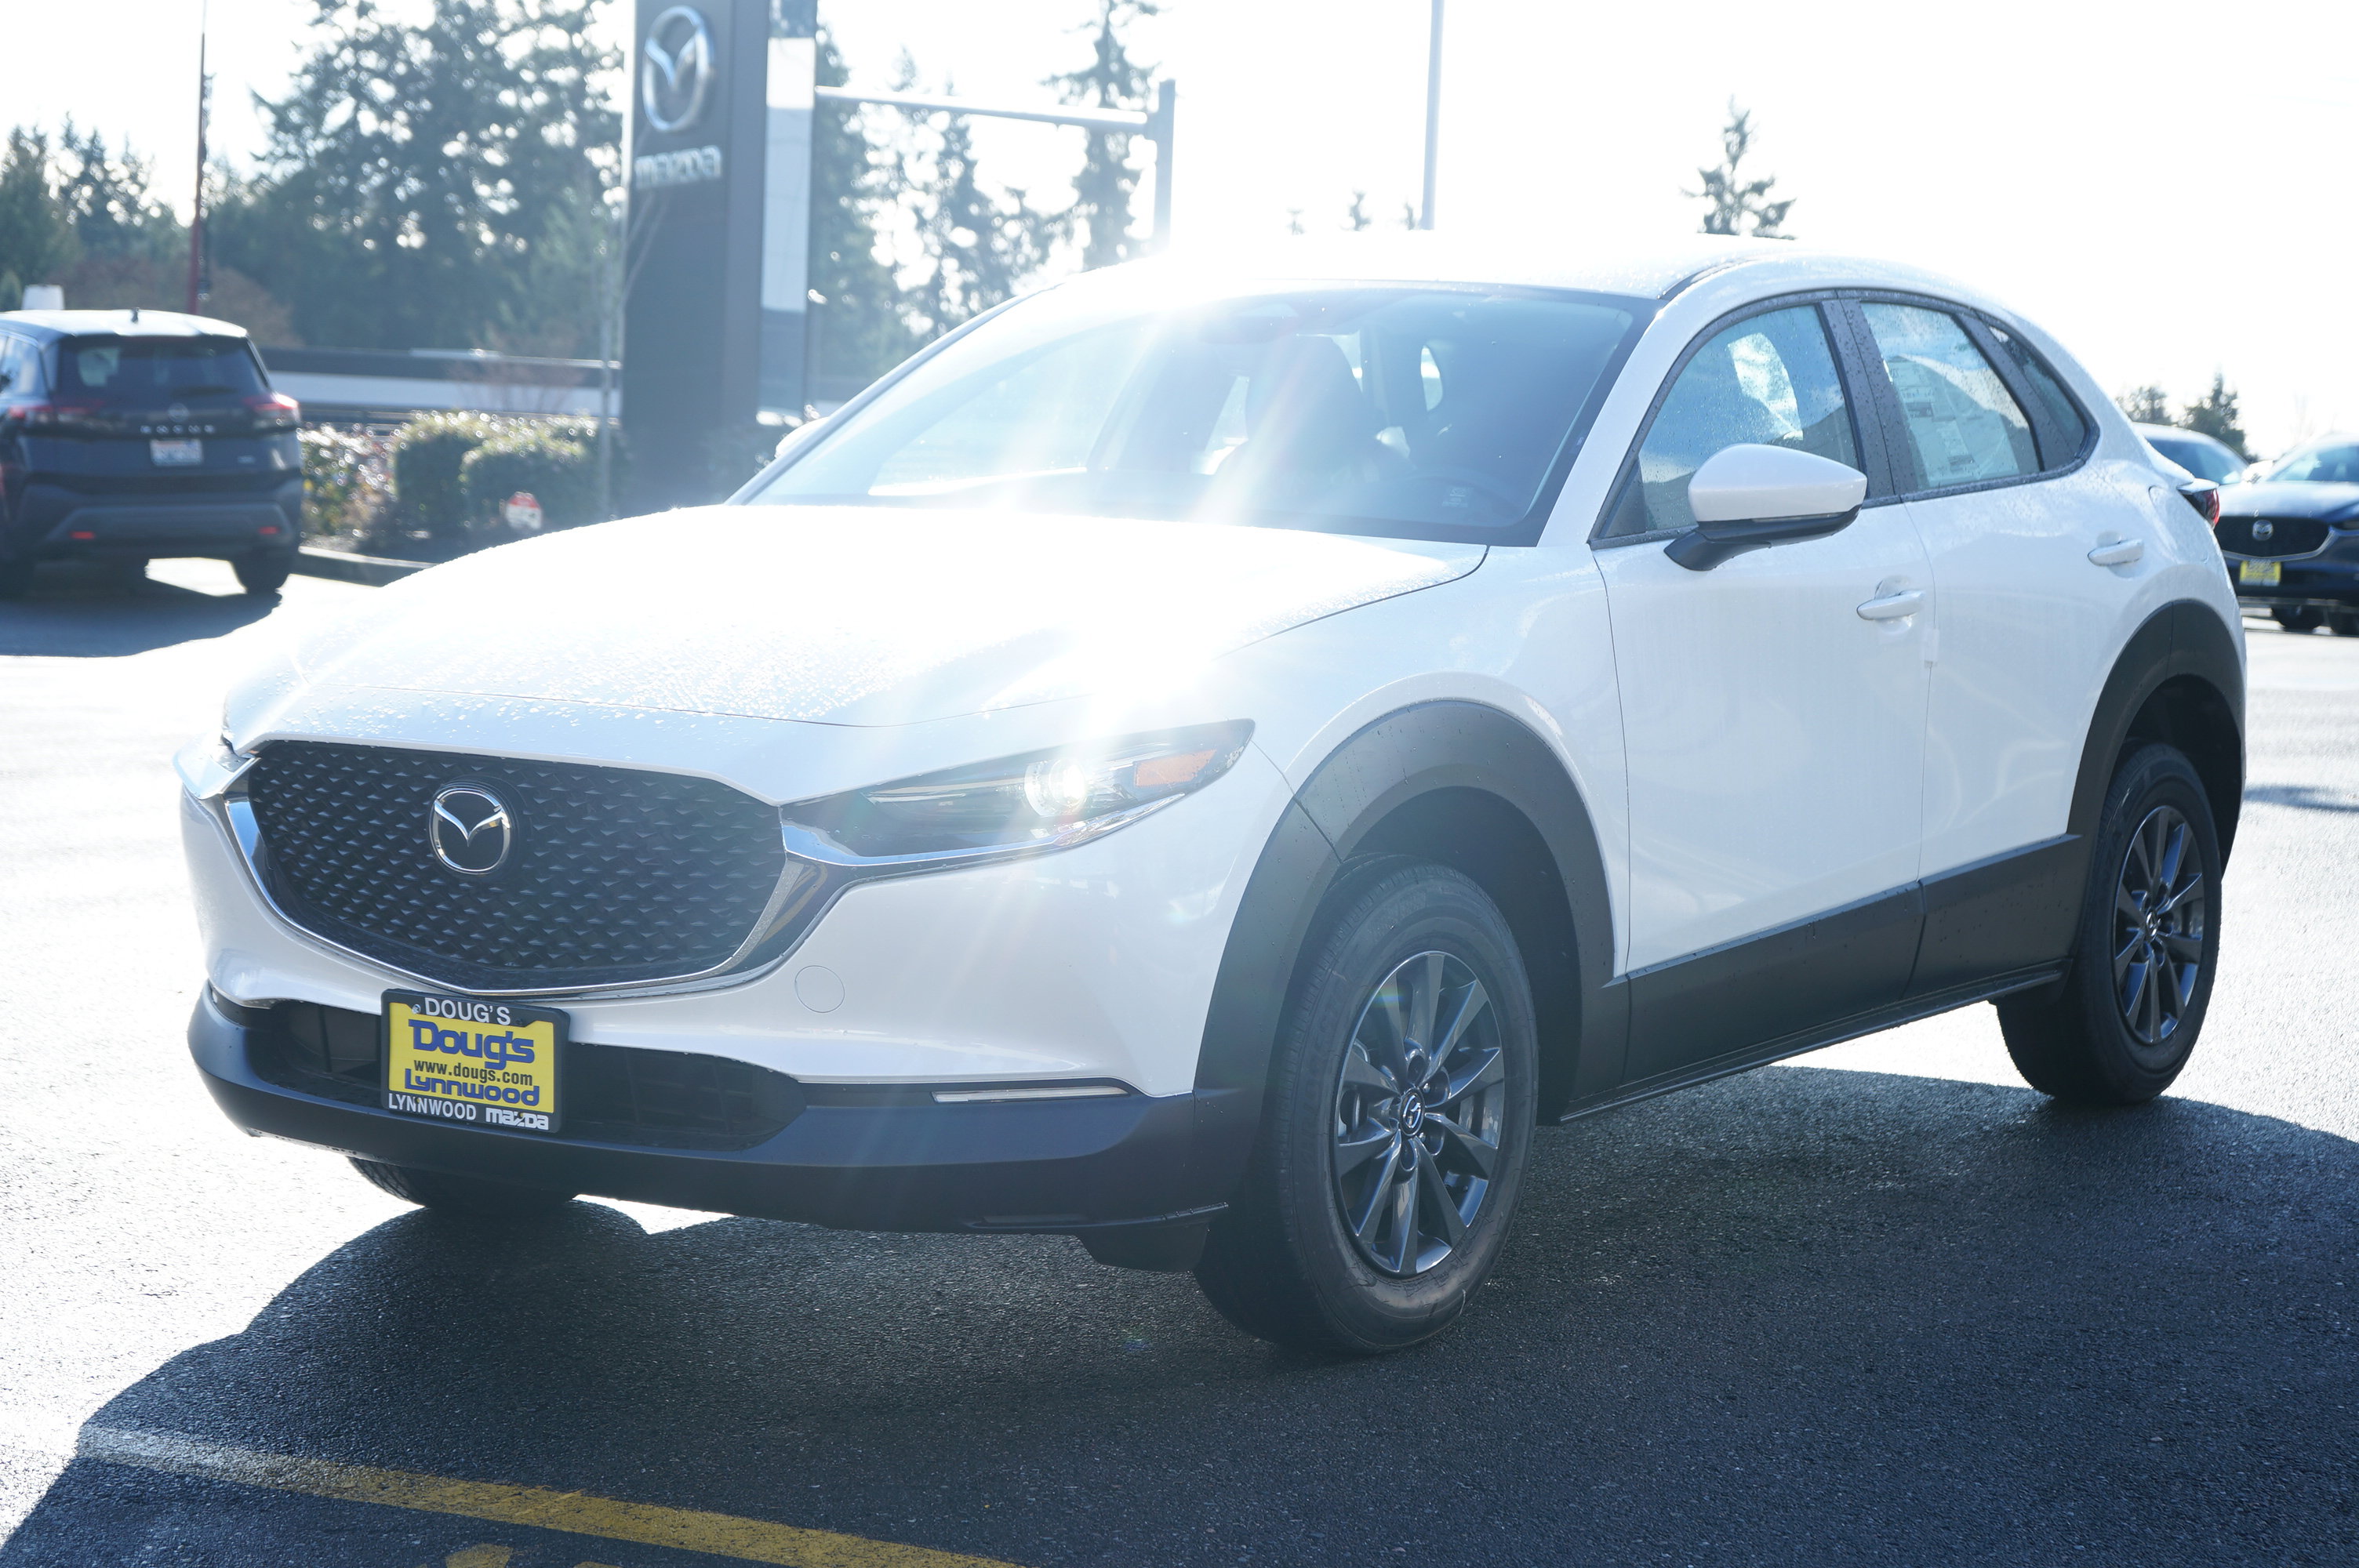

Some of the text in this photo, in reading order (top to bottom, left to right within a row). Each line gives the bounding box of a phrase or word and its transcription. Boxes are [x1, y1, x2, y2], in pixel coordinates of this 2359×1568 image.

[424, 997, 511, 1025] DOUG'S
[404, 1068, 540, 1107] Lynnwood
[413, 1060, 533, 1087] www.dougs.com
[388, 1093, 477, 1121] LYNNWOOD
